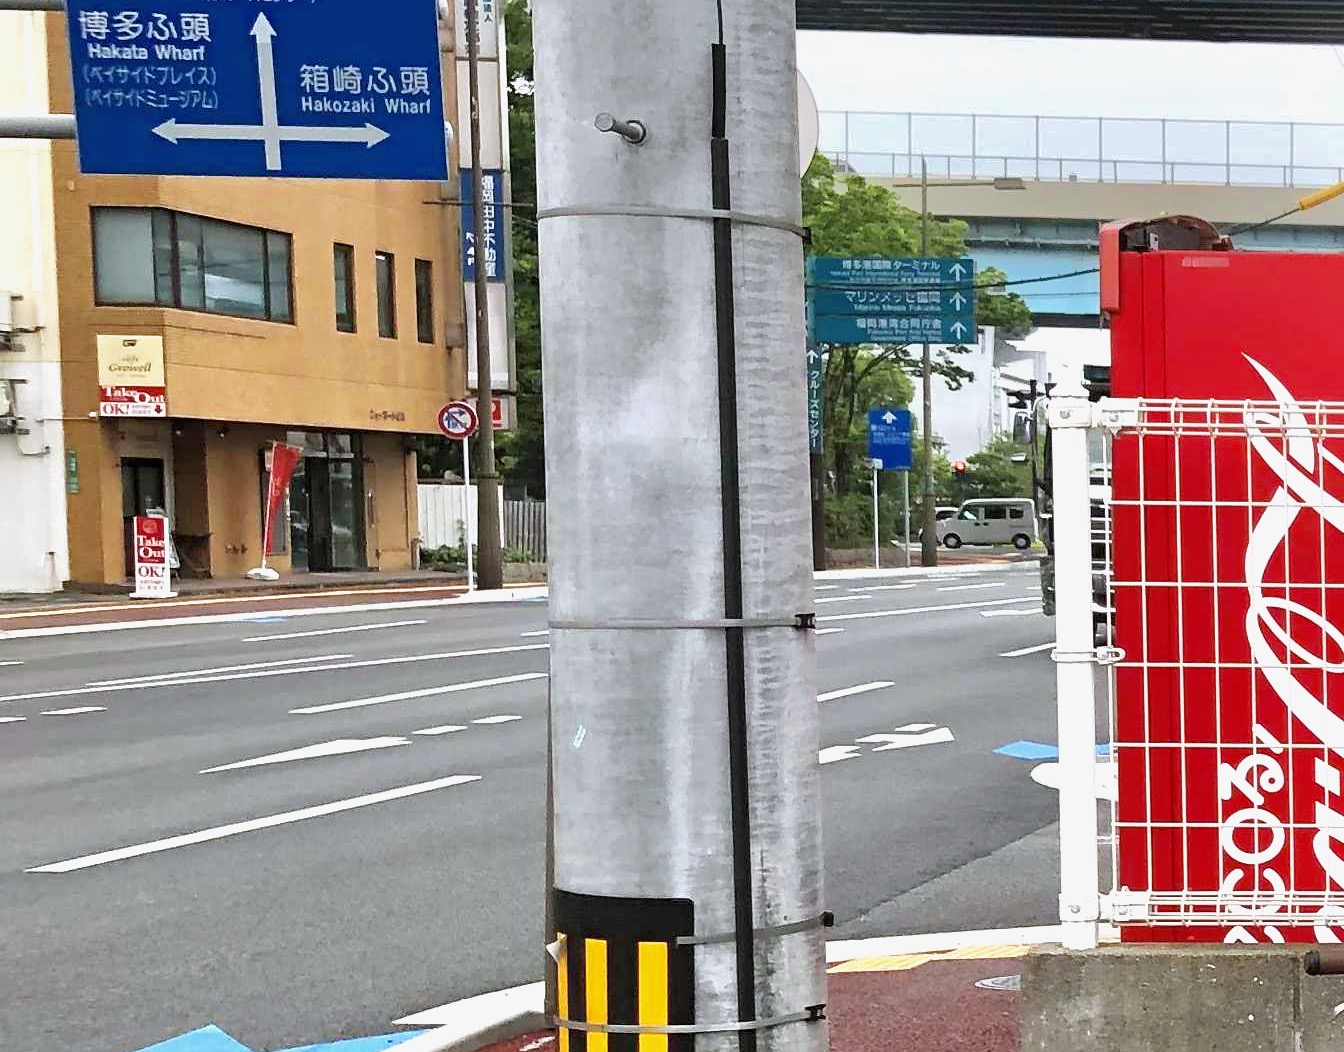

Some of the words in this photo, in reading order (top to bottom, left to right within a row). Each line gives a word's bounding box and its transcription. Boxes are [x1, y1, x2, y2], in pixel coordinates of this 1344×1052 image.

[79, 11, 212, 42] 博多ふ頭
[88, 43, 148, 60] Hakata
[154, 44, 206, 61] Wharf
[300, 64, 431, 96] 箱崎ふ頭
[301, 97, 375, 114] Hakozaki
[385, 98, 431, 114] Wharf
[102, 386, 138, 398] Take
[134, 392, 164, 404] Out
[103, 403, 130, 415] OK!
[137, 535, 165, 547] Take
[139, 547, 165, 559] Out
[138, 566, 166, 578] OK!
